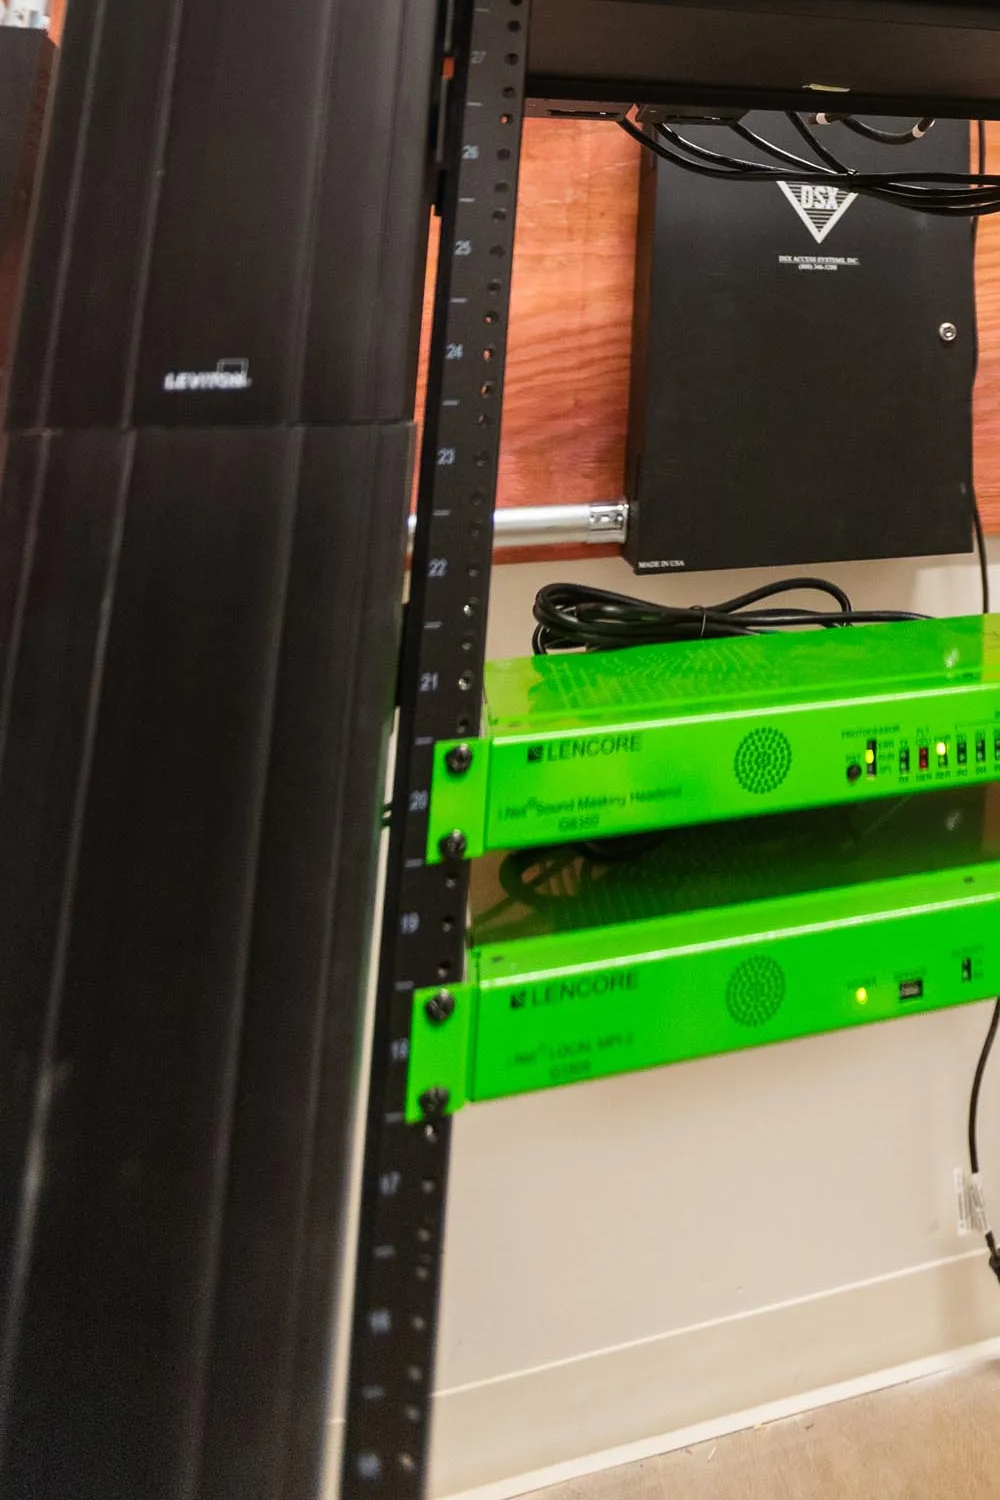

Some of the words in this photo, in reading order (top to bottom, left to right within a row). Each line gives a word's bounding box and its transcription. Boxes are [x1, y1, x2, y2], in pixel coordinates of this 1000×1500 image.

[471, 51, 487, 64] 27
[462, 145, 479, 159] 26
[800, 185, 839, 209] DSX
[454, 240, 472, 255] 25
[445, 344, 463, 360] 24
[164, 372, 249, 391] LEVITON
[436, 448, 455, 465] 23
[428, 558, 448, 578] 22
[638, 561, 660, 569] MADE
[660, 560, 669, 569] IN
[670, 559, 685, 568] USA
[420, 672, 438, 692] 21
[547, 733, 643, 762] LENCORE
[408, 790, 429, 812] 20
[536, 799, 575, 816] Sound
[577, 794, 628, 813] Masking
[401, 912, 420, 934] 19
[531, 970, 639, 1007] LENCORE
